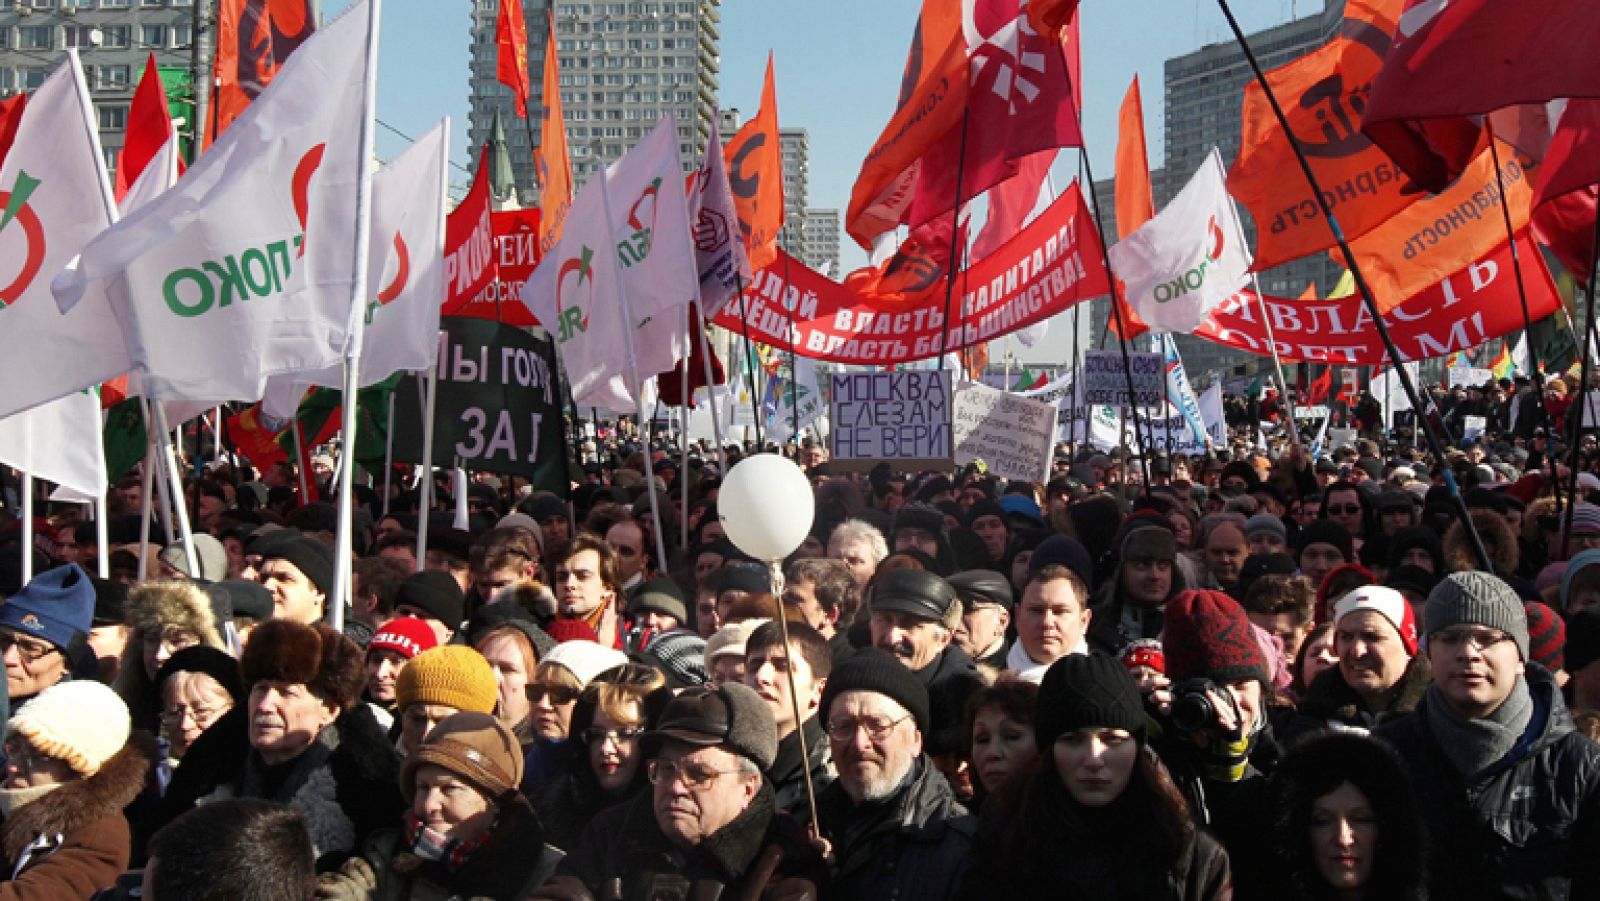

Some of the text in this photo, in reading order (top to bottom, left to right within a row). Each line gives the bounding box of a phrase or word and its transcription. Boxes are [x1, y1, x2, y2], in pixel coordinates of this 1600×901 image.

[834, 306, 944, 334] ВЛАСТЬ
[960, 216, 1076, 320] КАПИТАЛА!
[806, 329, 908, 360] ВЛАСТЬ
[914, 250, 1086, 356] БОЛЬШИНСТВА!
[832, 371, 945, 402] МОСКВА
[455, 406, 517, 462] ЗА
[837, 400, 947, 428] СЛЕЗАМ
[835, 427, 871, 458] НЕ
